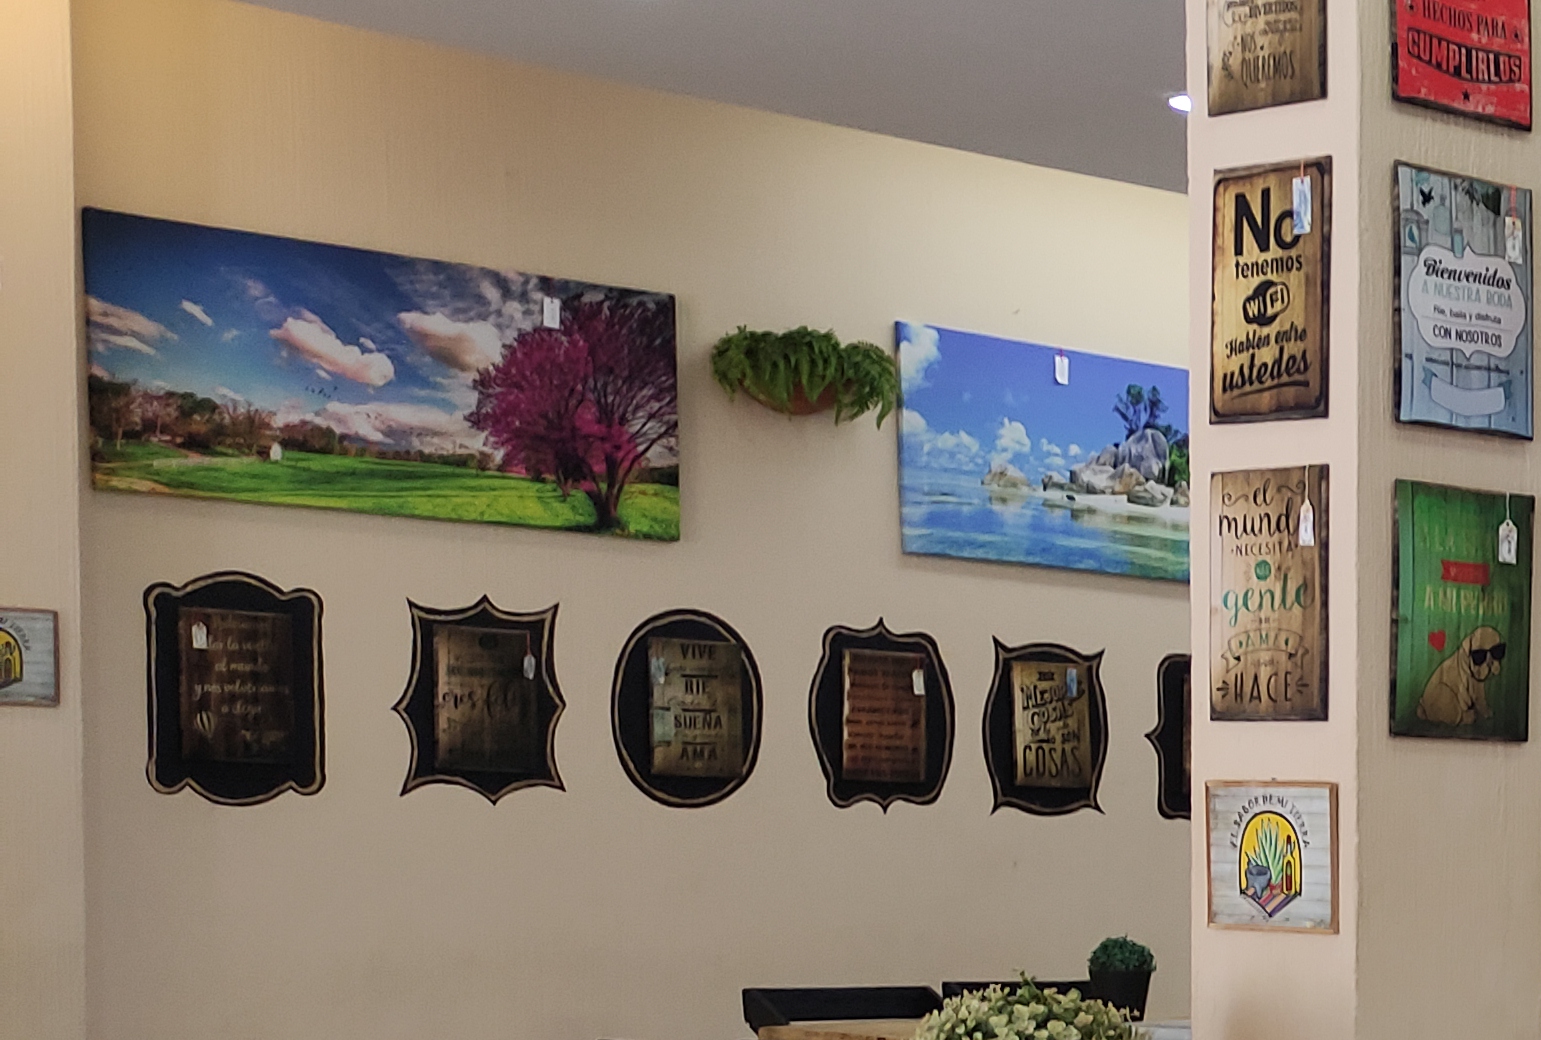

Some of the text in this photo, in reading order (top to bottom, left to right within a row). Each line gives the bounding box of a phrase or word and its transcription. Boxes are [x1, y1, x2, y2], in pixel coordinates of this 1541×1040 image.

[1422, 0, 1507, 39] HECHOS PARA
[1241, 49, 1296, 89] QUEREMOS
[1408, 30, 1521, 82] CUMPLIRLOS
[1234, 187, 1301, 256] No
[1234, 254, 1303, 280] tenemos
[1423, 258, 1512, 291] Bienvenidos
[1421, 279, 1513, 311] A NUESTRA BODA
[1225, 321, 1308, 359] Hablen entre
[1432, 324, 1503, 348] CON NOSOTROS
[1222, 346, 1312, 394] ustedes
[1252, 477, 1275, 507] el
[1218, 497, 1300, 540] mund
[1235, 539, 1293, 557] NECESITA
[1223, 575, 1314, 627] gente
[1234, 671, 1292, 703] HACE
[680, 746, 719, 761] AMA
[1023, 744, 1083, 778] COSAS
